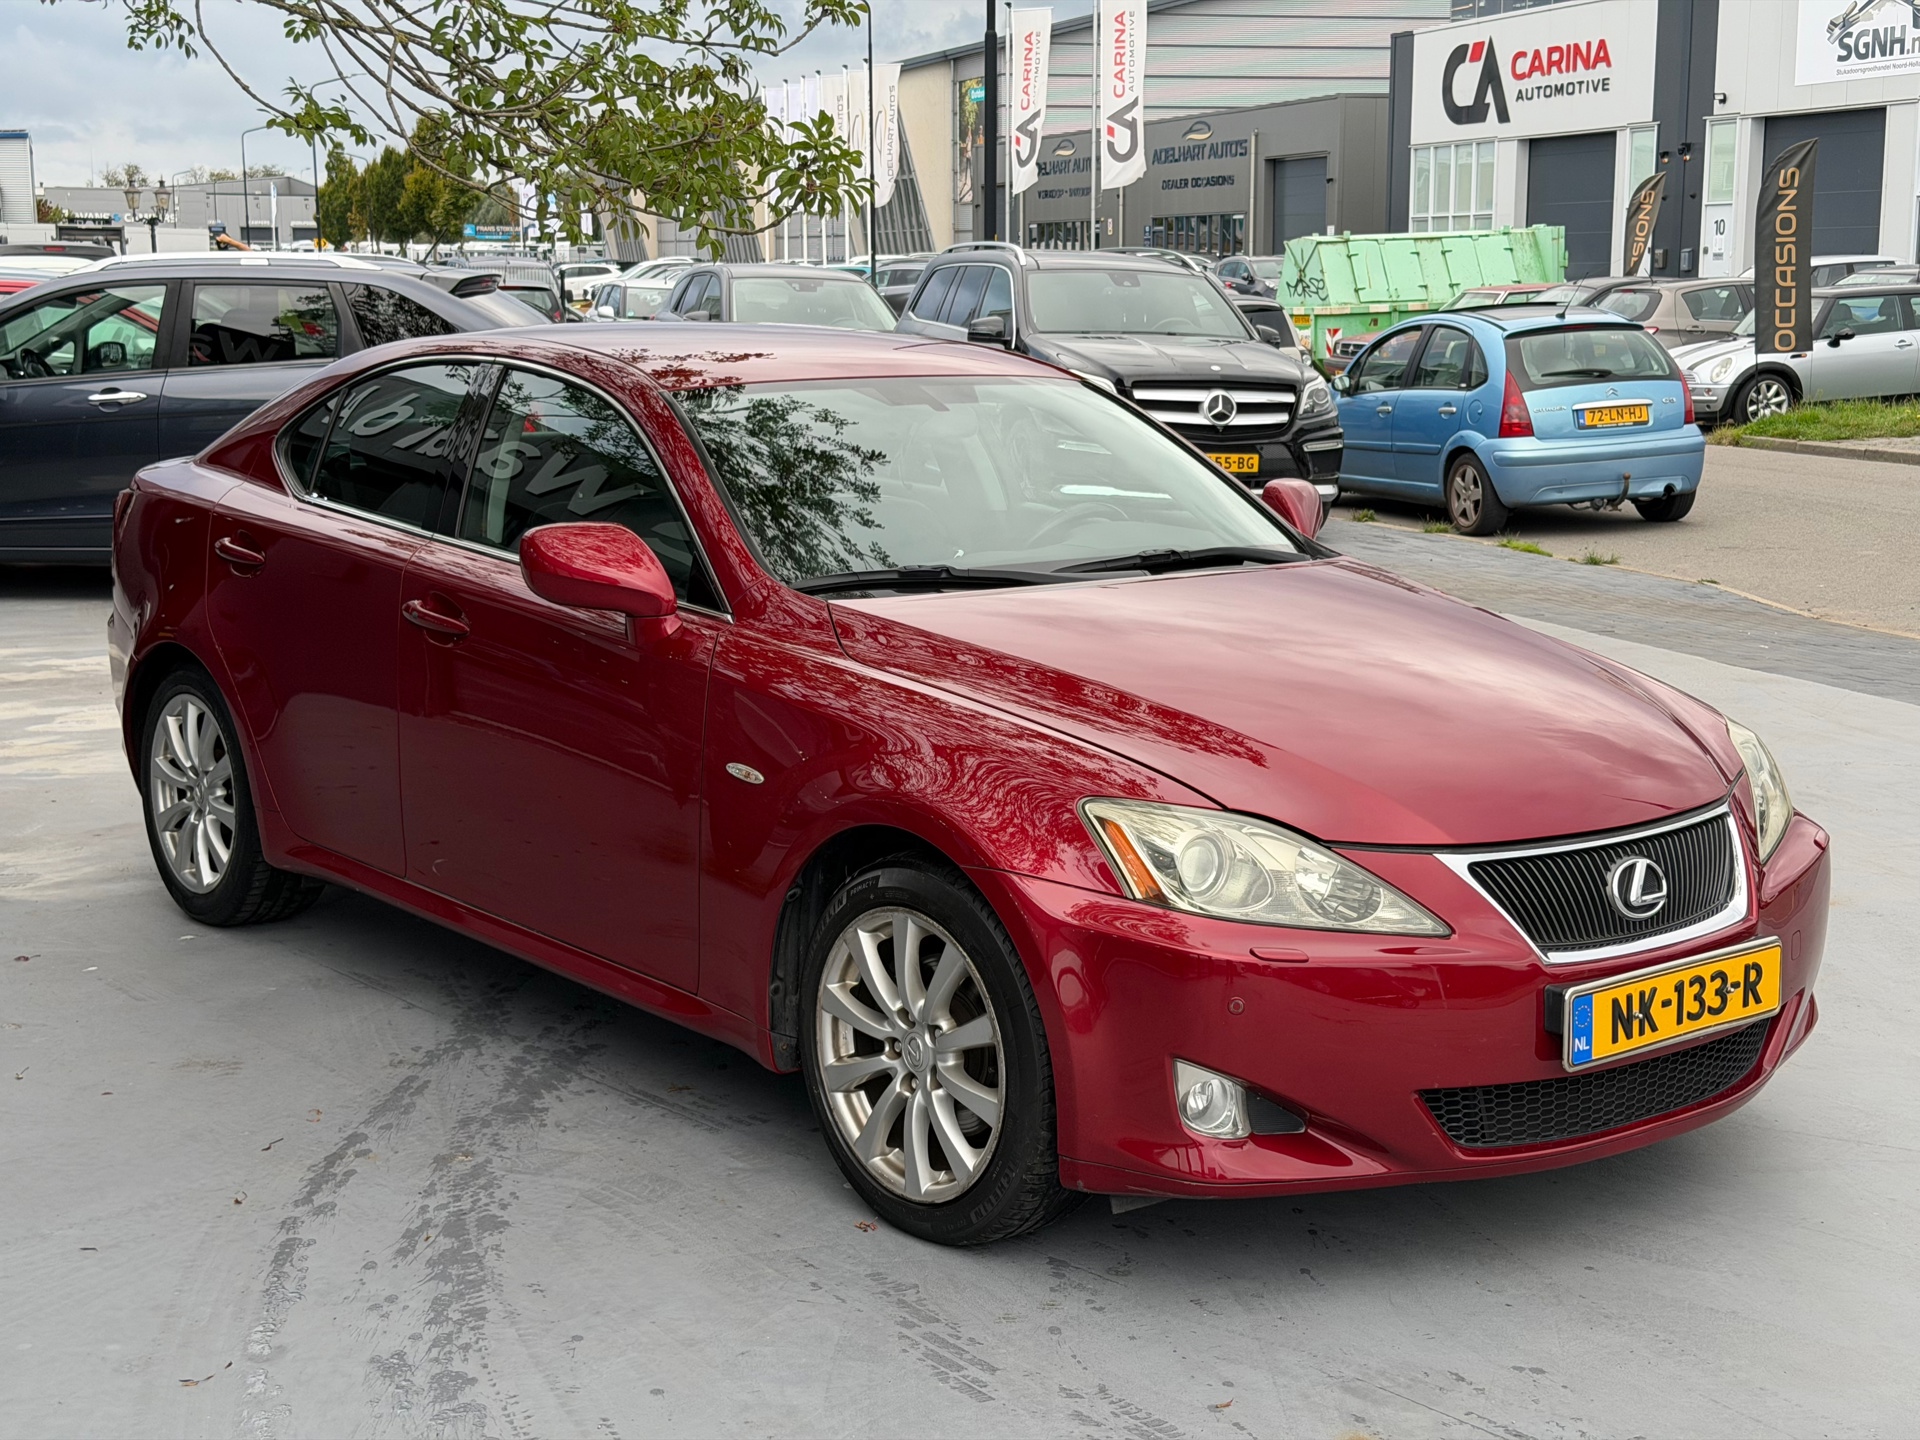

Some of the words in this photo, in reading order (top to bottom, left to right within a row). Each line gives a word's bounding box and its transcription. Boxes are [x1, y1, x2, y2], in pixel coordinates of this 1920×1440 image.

[1113, 10, 1126, 98] CARINA
[1128, 10, 1136, 93] AUTOMOTIVE
[1511, 39, 1612, 81] CARINA
[1020, 31, 1034, 111] CARINA
[1515, 77, 1611, 102] AUTOMOTIVE
[1151, 143, 1208, 166] ADELHART
[1208, 139, 1248, 160] AUTO'S
[1161, 177, 1189, 190] DEALER
[1190, 175, 1235, 188] OCCASIONS
[1714, 219, 1726, 236] 10
[1774, 167, 1799, 352] OCCASIONS
[1590, 407, 1643, 423] 72-LN-HJ
[1208, 456, 1255, 470] 55-BG
[1611, 961, 1763, 1045] NK-133-R
[1574, 1035, 1590, 1052] NL
